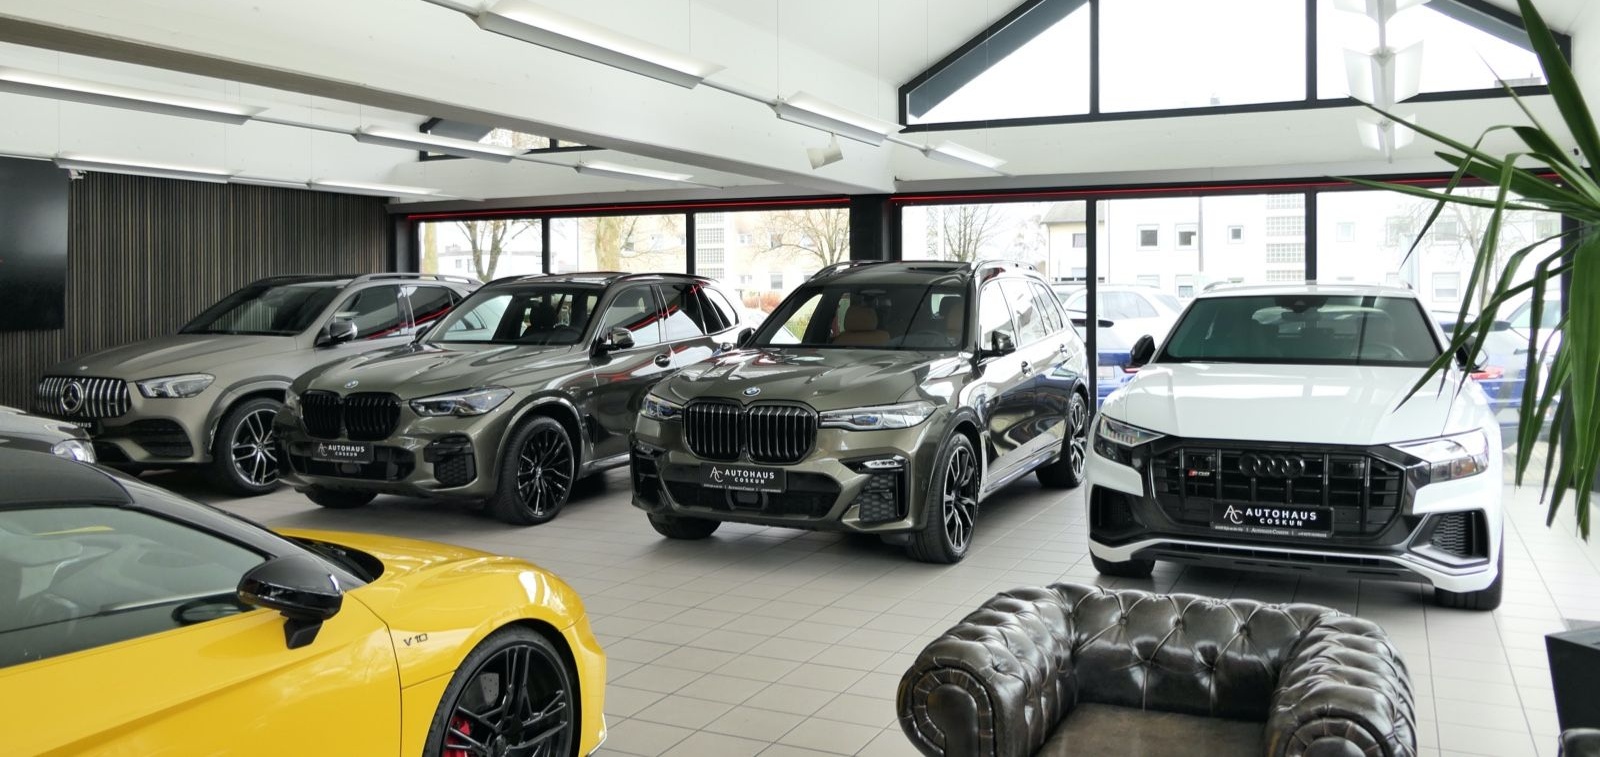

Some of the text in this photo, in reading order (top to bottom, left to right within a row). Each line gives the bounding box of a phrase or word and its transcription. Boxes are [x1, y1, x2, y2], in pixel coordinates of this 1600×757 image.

[327, 444, 365, 453] AUTOHAUS
[724, 469, 775, 479] AUTOHAUS
[734, 477, 765, 485] COSKUN
[1245, 507, 1317, 521] AUTOHAUS
[1259, 518, 1303, 527] COSKUN
